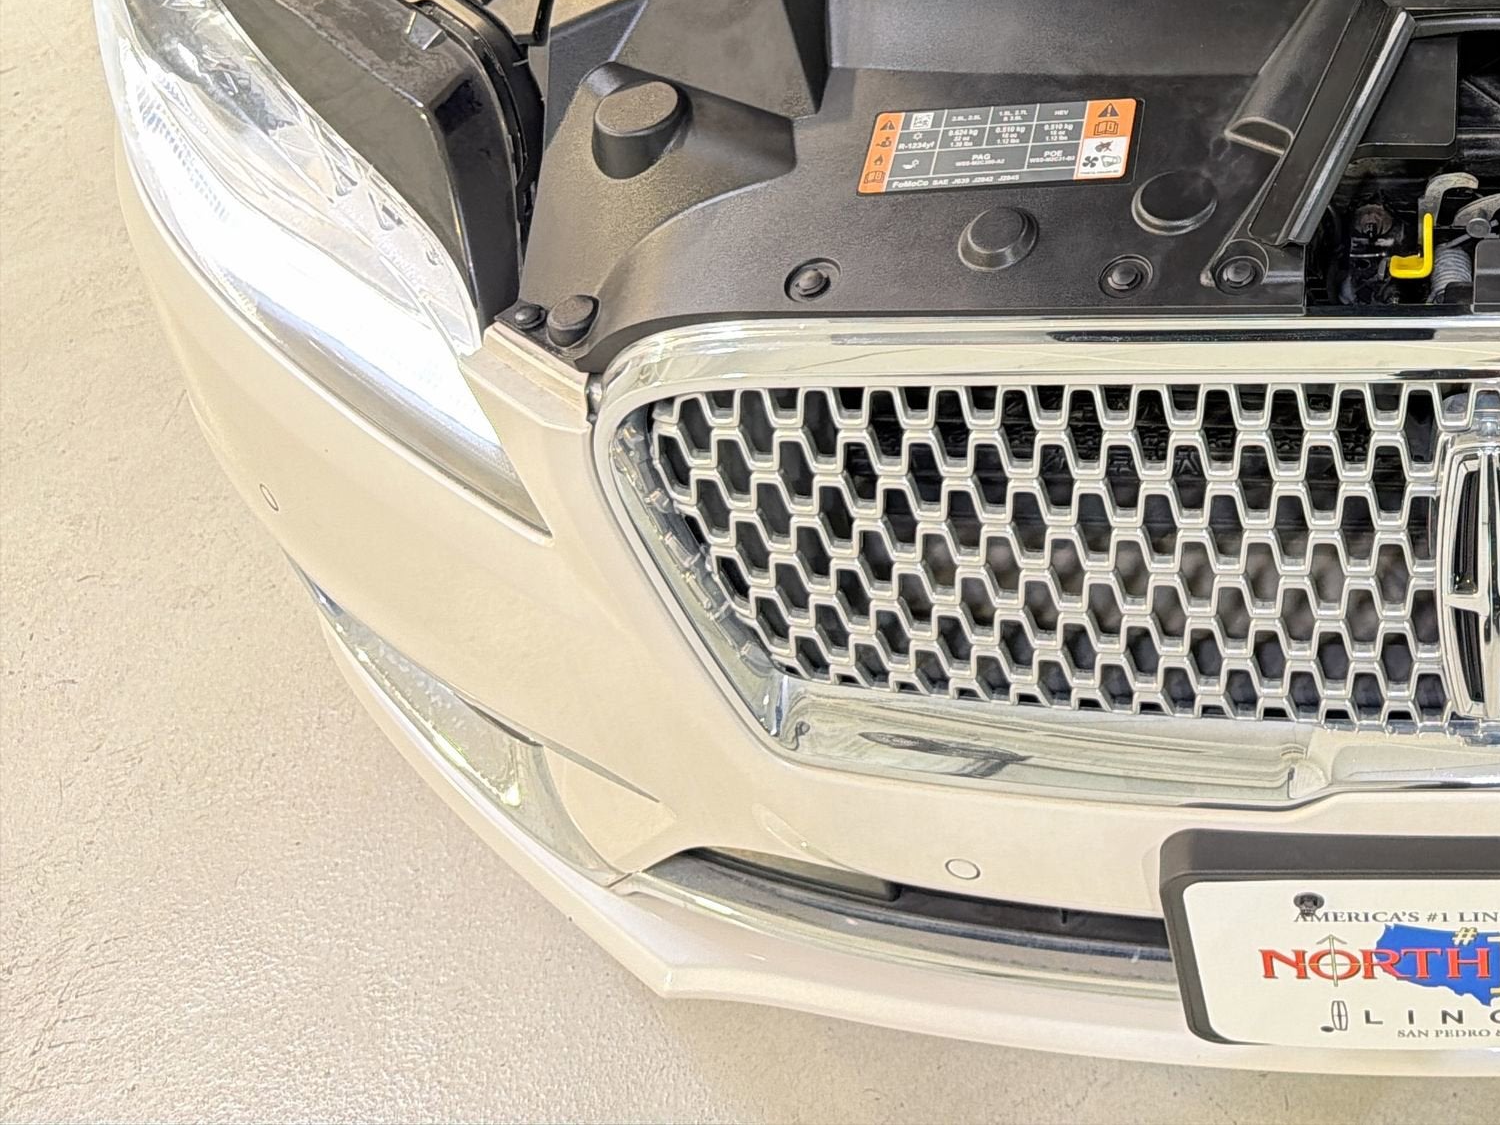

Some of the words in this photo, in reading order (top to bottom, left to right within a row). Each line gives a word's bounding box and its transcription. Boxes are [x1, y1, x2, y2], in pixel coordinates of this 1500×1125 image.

[898, 141, 935, 150] R-1234yf
[972, 153, 991, 161] PAG
[1043, 150, 1063, 158] POE
[892, 179, 929, 188] FoMoCo
[1427, 912, 1448, 923] #1
[1259, 948, 1492, 981] NORTH
[1397, 1029, 1429, 1038] SAN
